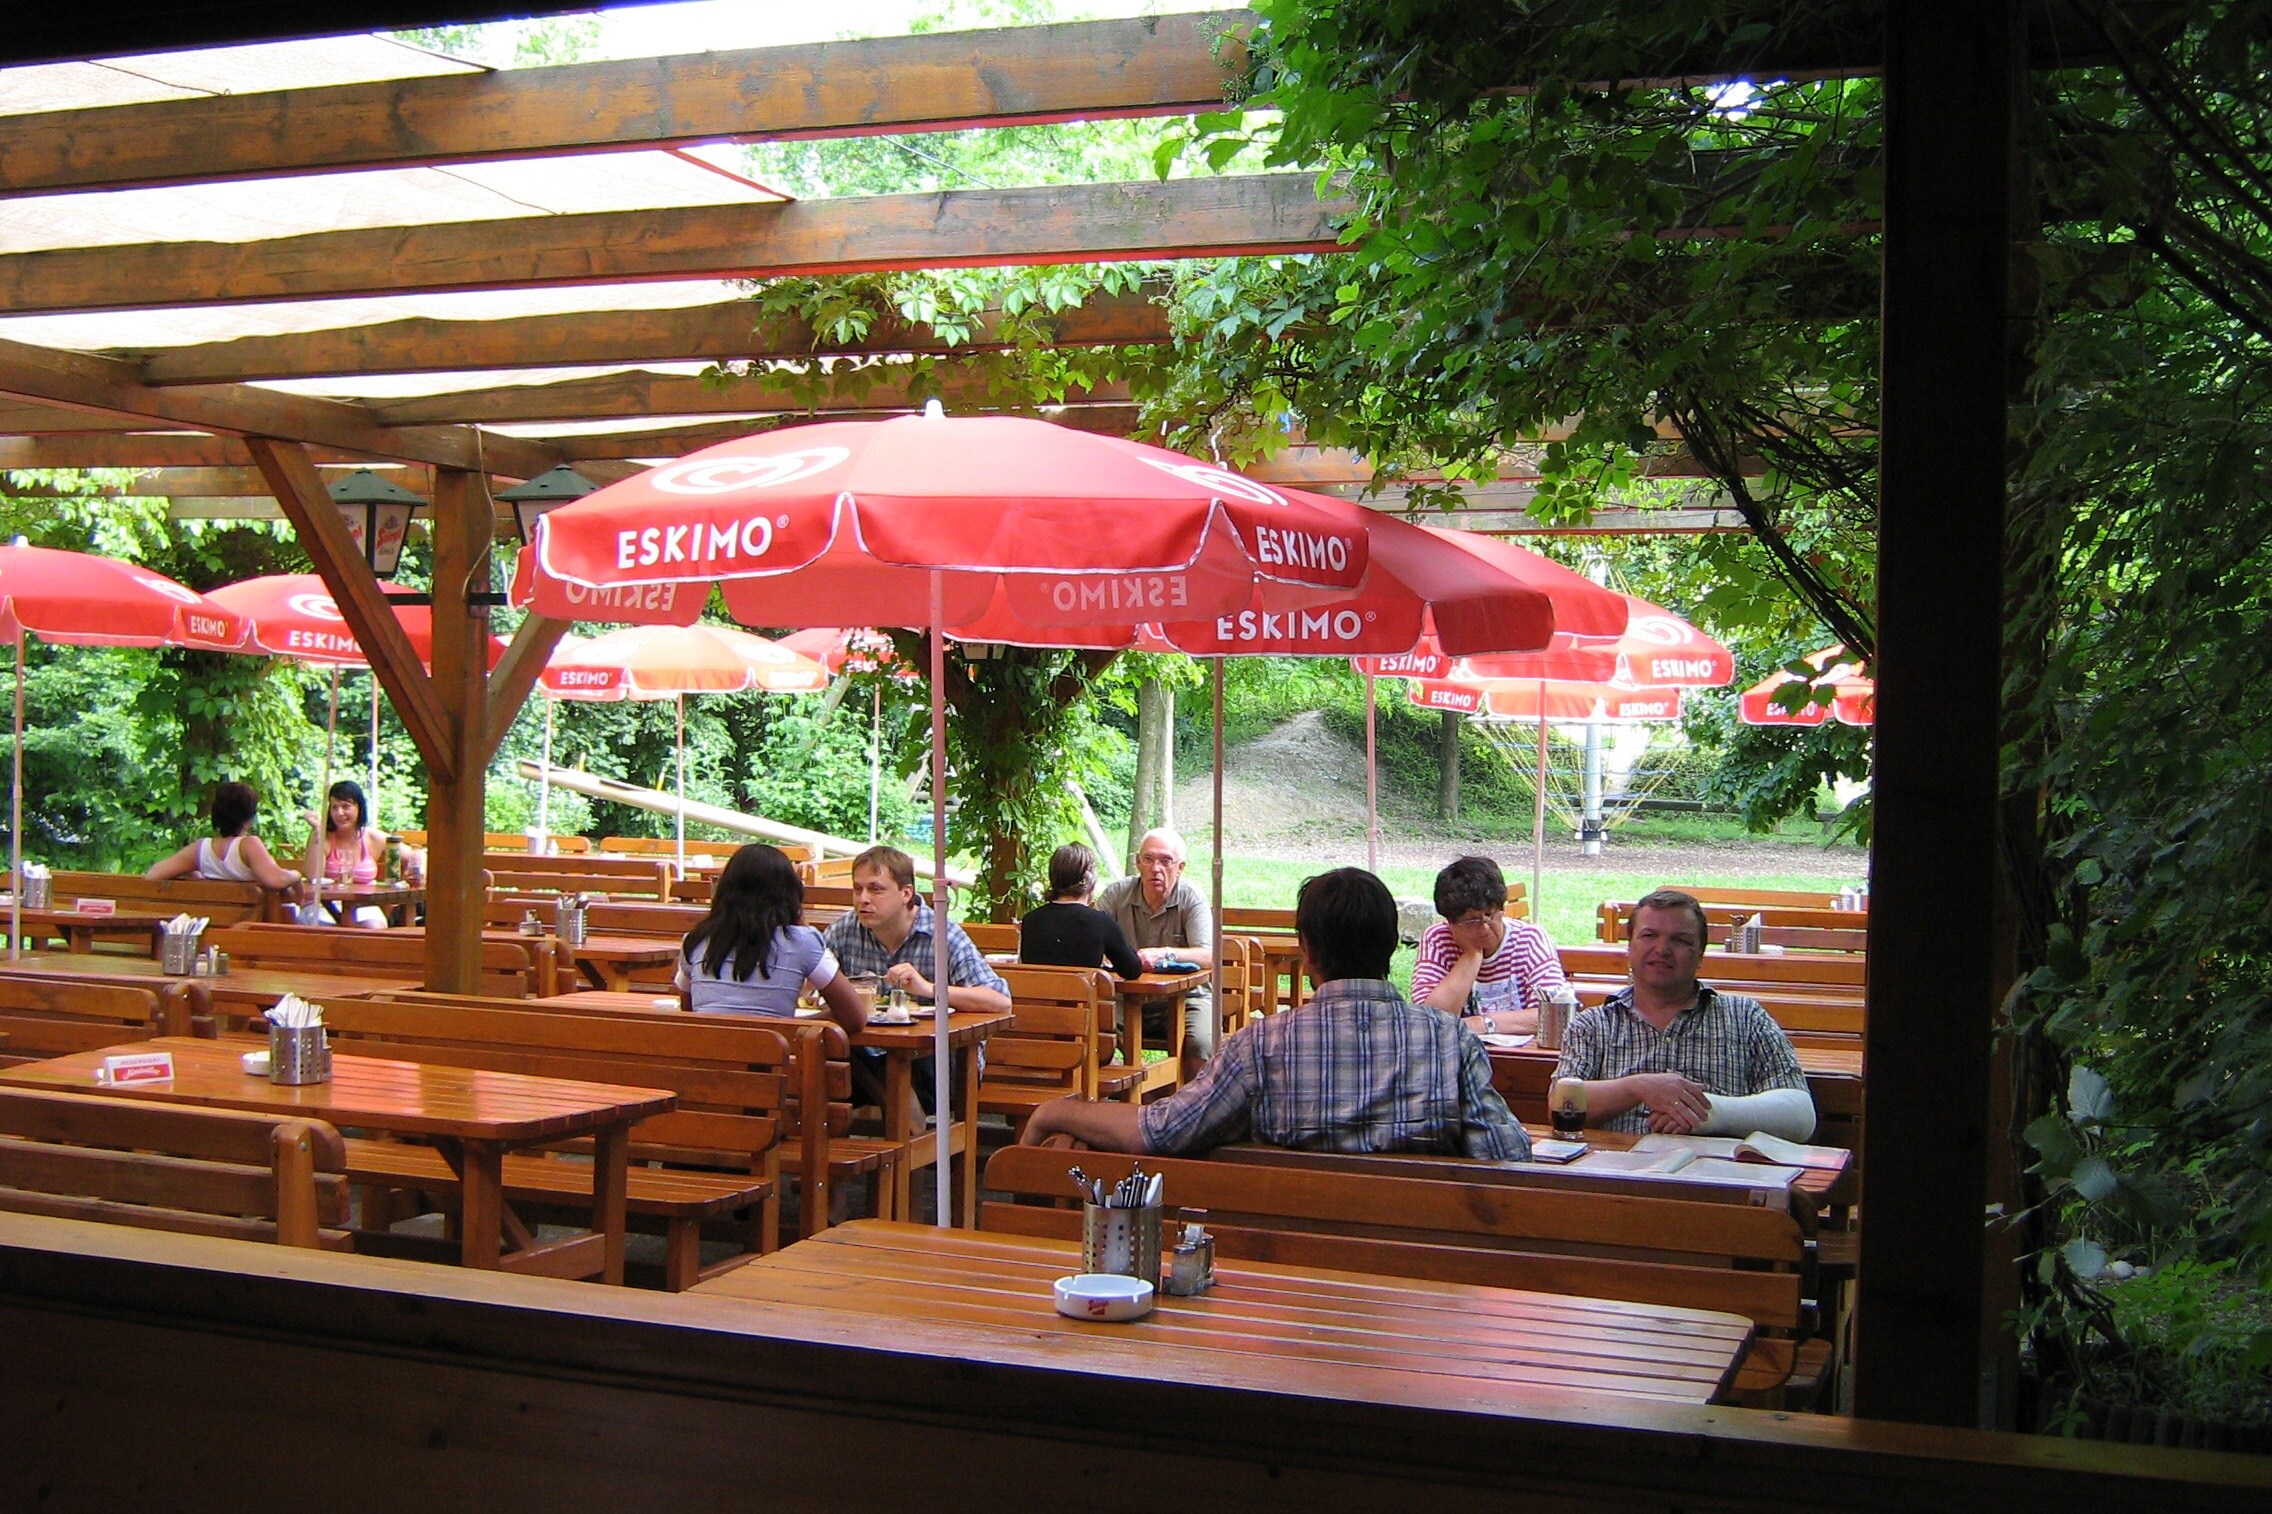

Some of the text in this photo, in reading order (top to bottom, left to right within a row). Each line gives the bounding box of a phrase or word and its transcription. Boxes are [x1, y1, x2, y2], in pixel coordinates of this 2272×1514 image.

[616, 516, 773, 569] ESKIMO
[1256, 525, 1348, 572] ESKIMO
[190, 614, 226, 638] ESKIMO
[1216, 610, 1363, 641] ESKIMO
[1379, 654, 1438, 674] ESKIMO
[1651, 658, 1713, 680] ESKIMO
[560, 670, 610, 686] ESKIMO
[1431, 690, 1472, 708] ESKIMO
